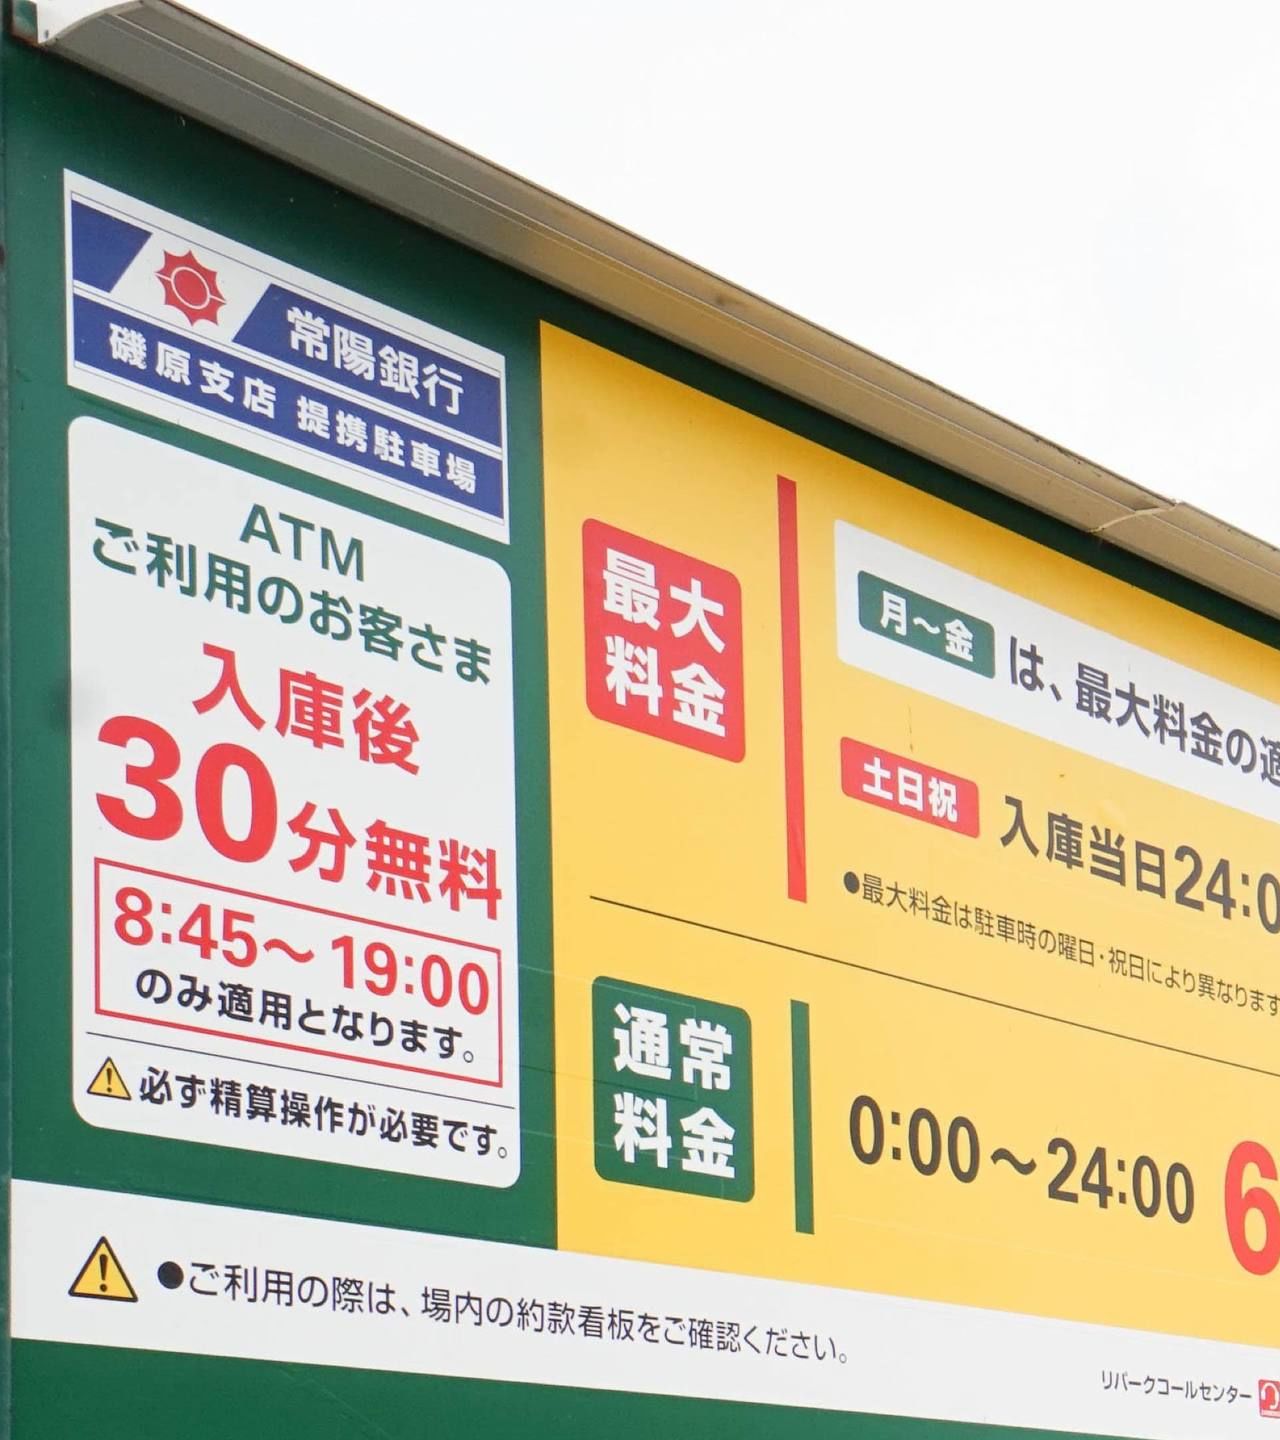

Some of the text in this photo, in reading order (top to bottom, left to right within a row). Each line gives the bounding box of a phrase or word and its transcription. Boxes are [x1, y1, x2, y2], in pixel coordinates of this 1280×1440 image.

[108, 322, 477, 494] 磯原支店 提携駐車場
[286, 306, 465, 416] 常陽銀行
[240, 503, 365, 582] ATM
[92, 517, 491, 686] ご利用のお客さま
[603, 547, 725, 654] 最大
[193, 642, 420, 776] 入庫後
[606, 634, 726, 737] 料金
[96, 715, 502, 920] 30分無料
[862, 756, 957, 823] 土日祝
[136, 968, 474, 1063] のみ適用となります。
[613, 1002, 733, 1090] 通常
[139, 1066, 508, 1159] 必ず精算操作が必要です。
[613, 1091, 736, 1178] 料金
[188, 1260, 848, 1364] ご利用の際は、場内の約款看板をご確認ください。
